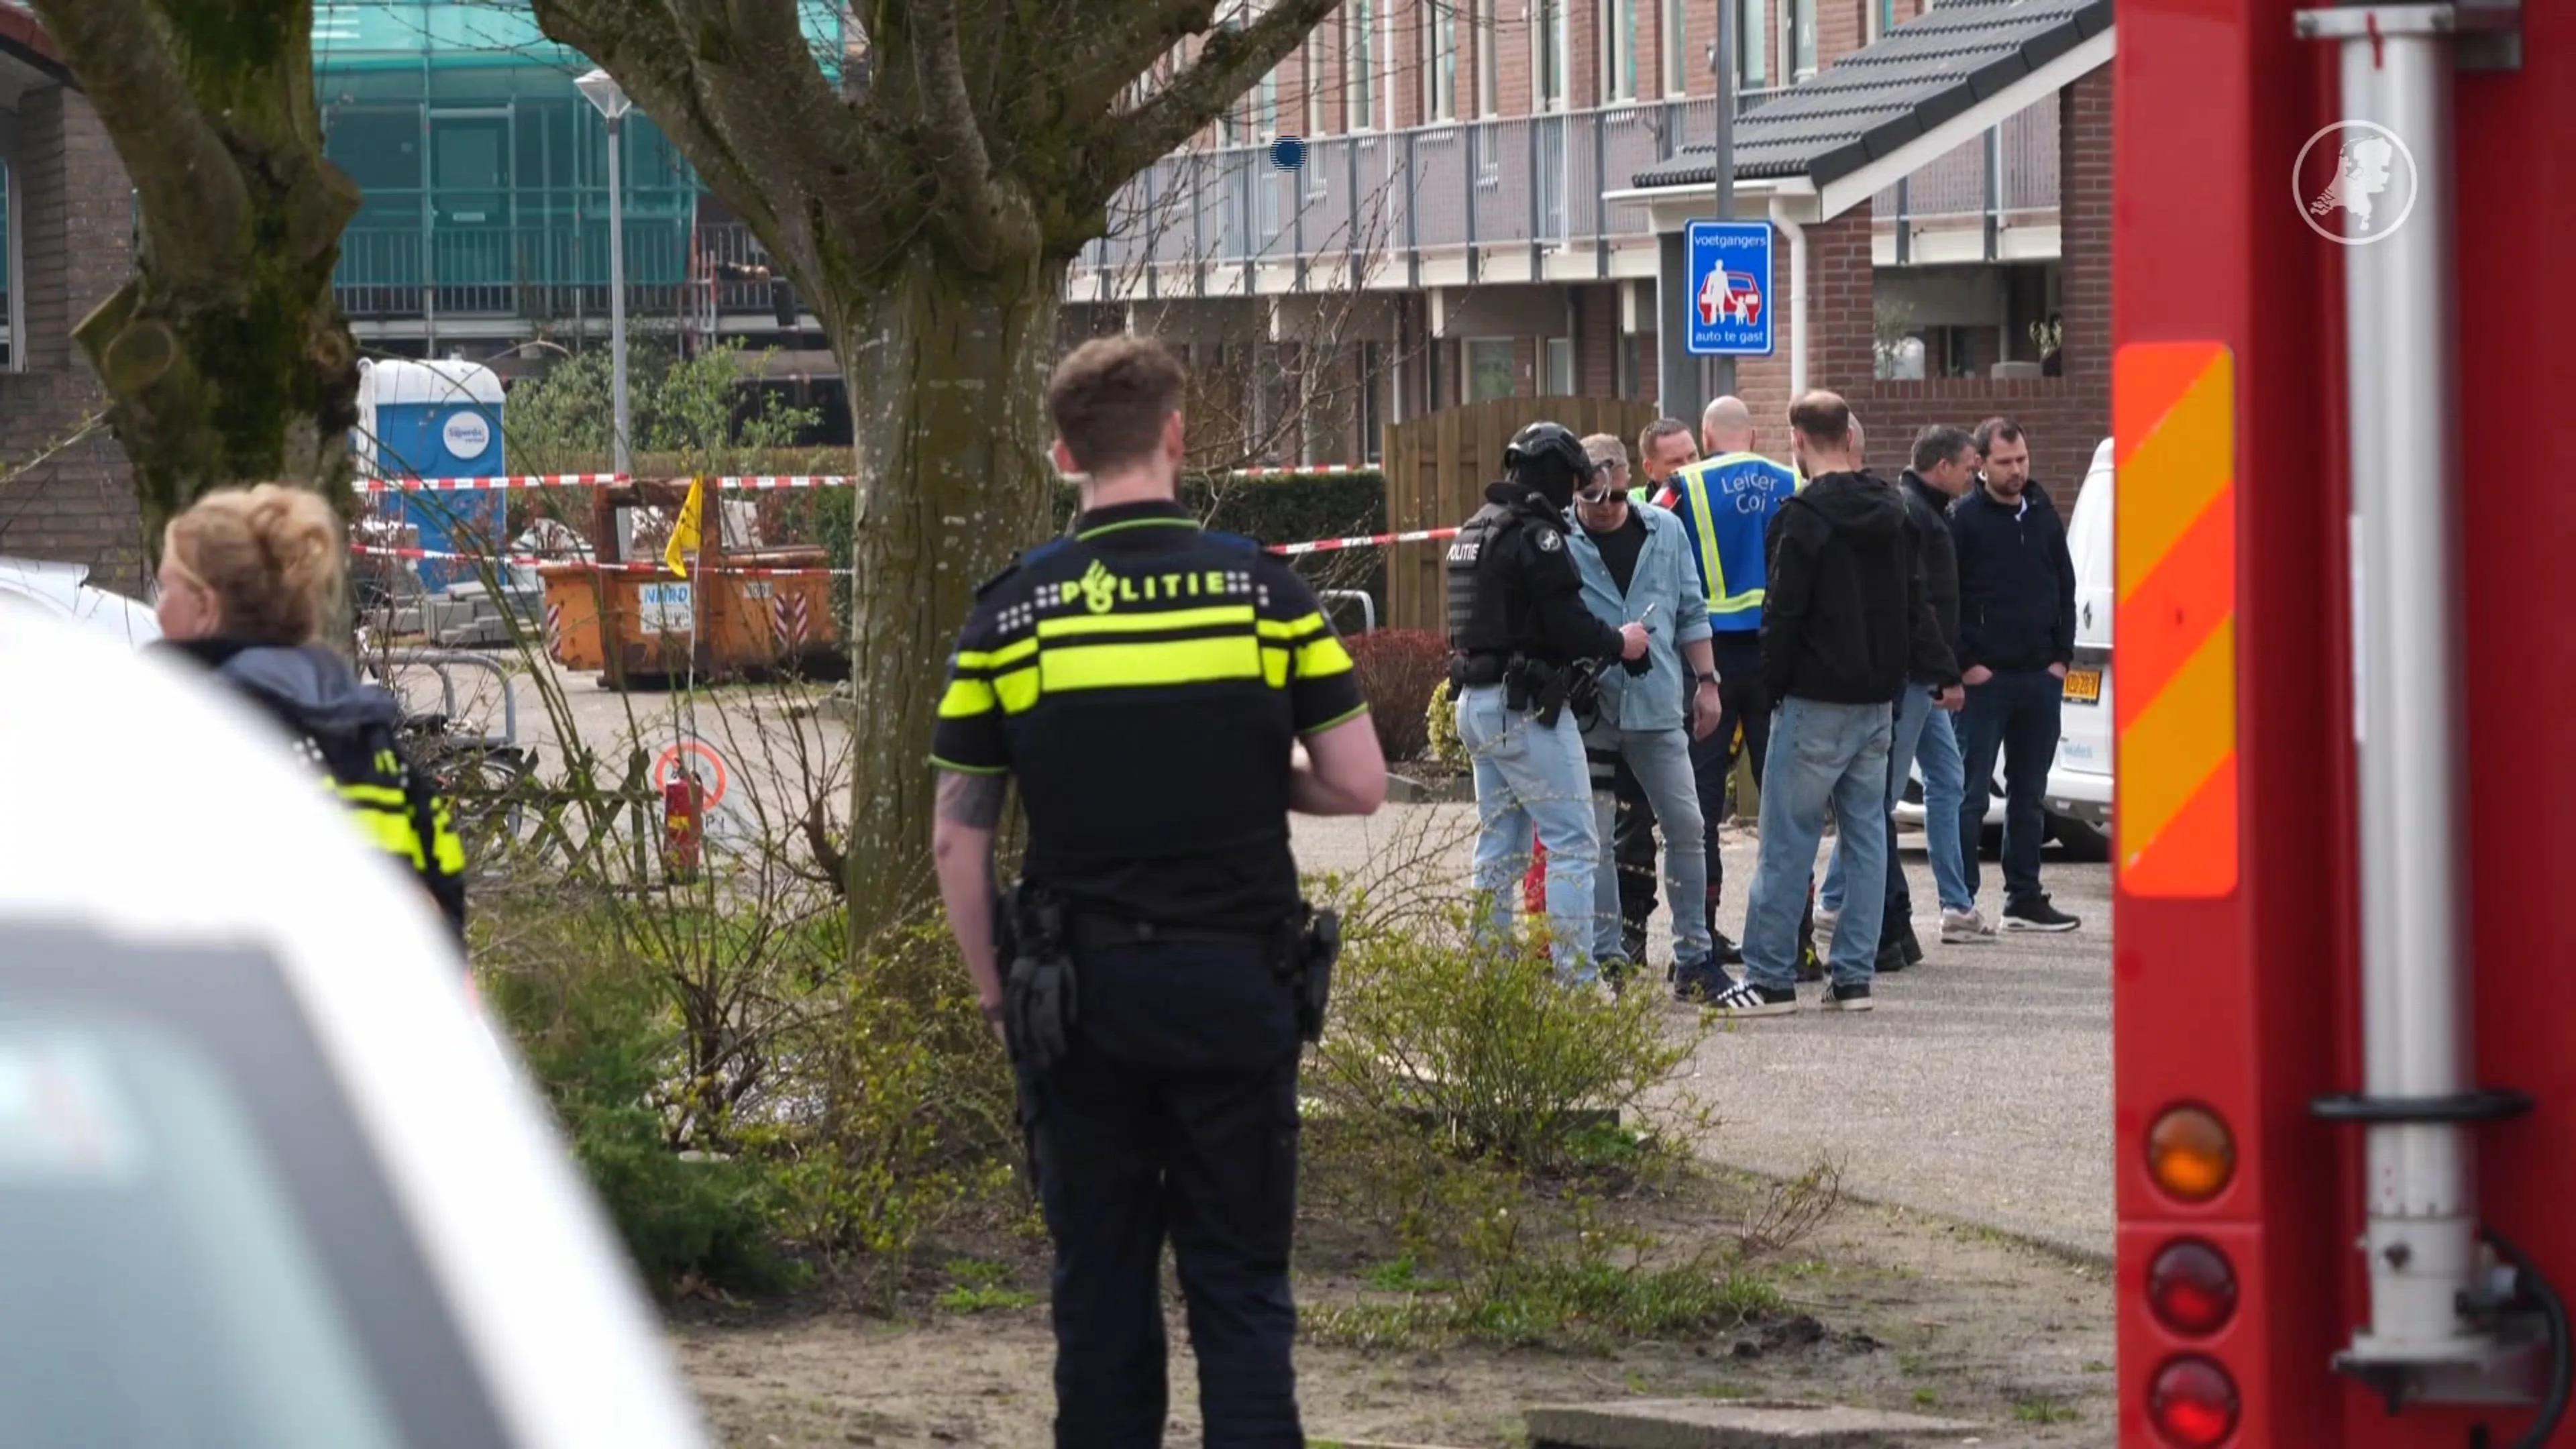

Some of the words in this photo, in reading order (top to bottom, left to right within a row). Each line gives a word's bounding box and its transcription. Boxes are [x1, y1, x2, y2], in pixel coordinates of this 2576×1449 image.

[1694, 233, 1767, 249] voetgangers
[1695, 331, 1721, 342] auto
[1724, 331, 1736, 342] te
[1740, 331, 1764, 345] gast
[1061, 559, 1224, 614] POLITIE
